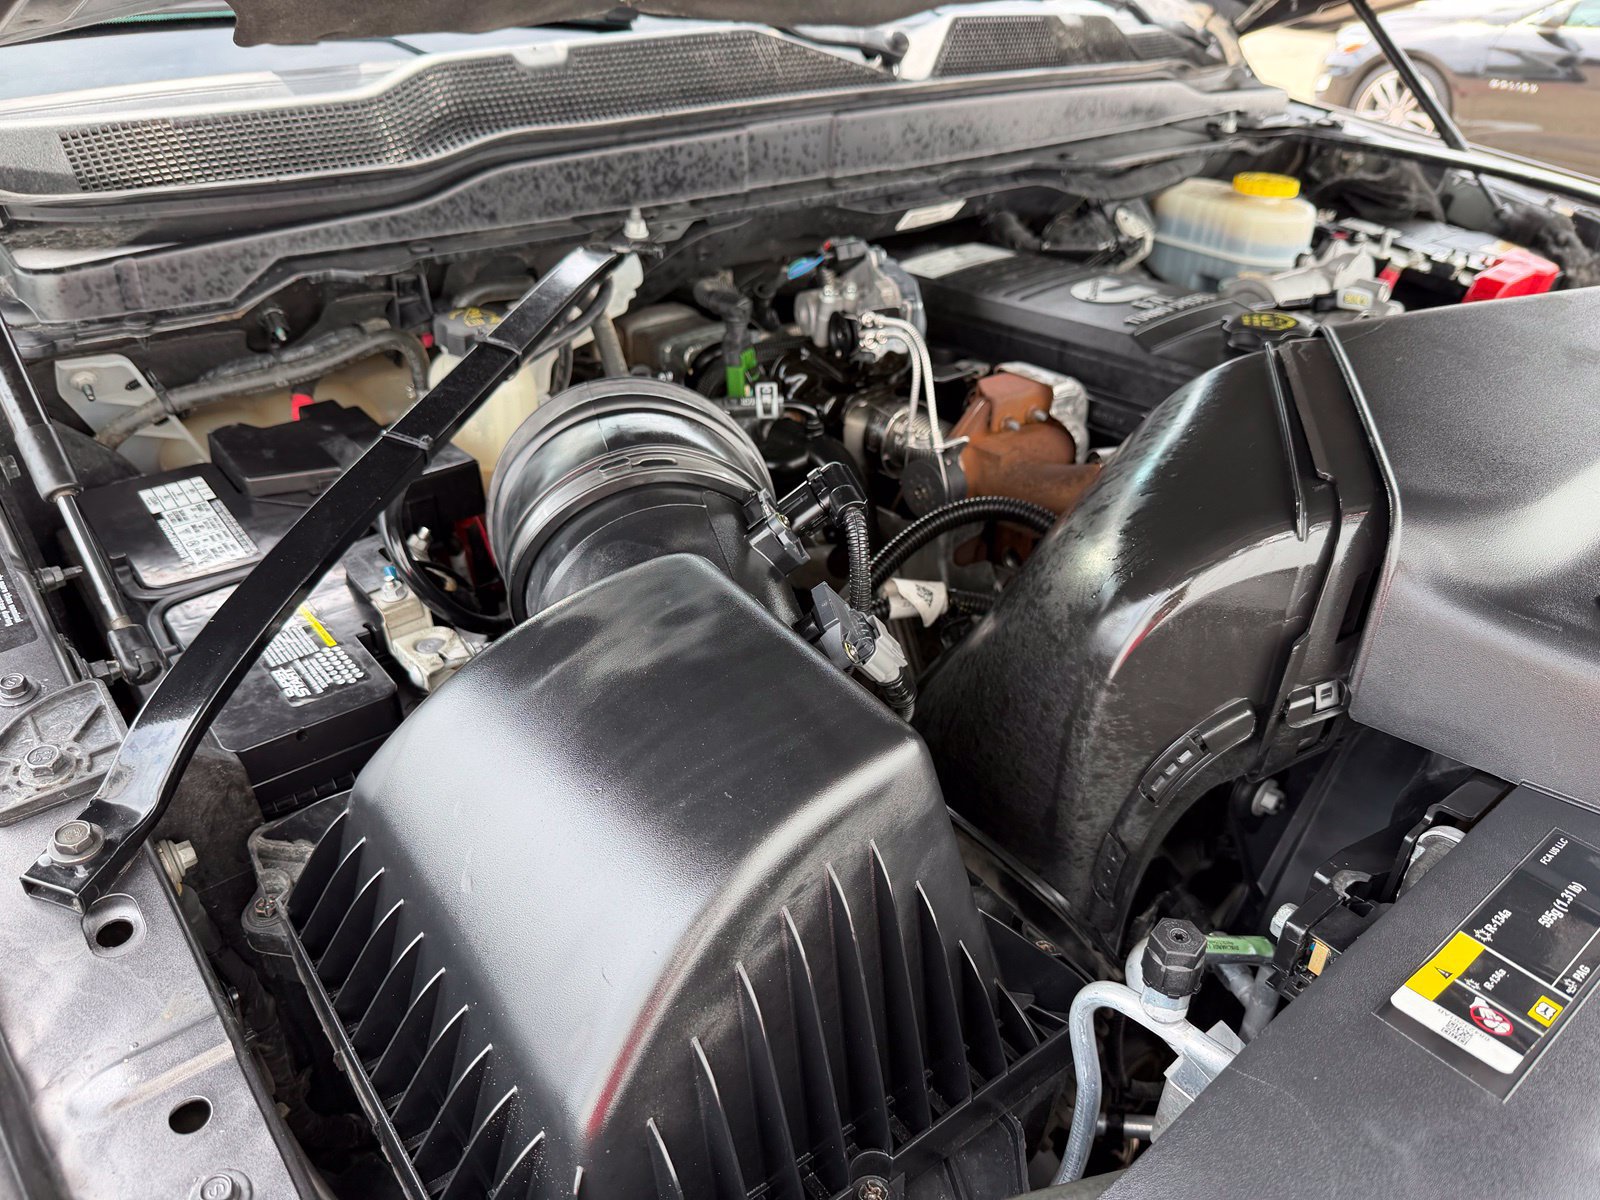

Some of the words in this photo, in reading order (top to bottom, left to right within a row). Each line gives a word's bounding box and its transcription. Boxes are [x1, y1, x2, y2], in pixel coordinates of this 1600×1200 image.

[270, 669, 296, 698] SUPER
[280, 665, 311, 698] START
[1540, 853, 1554, 866] FCA
[1550, 846, 1561, 856] US
[1556, 837, 1569, 849] LLC
[1538, 908, 1564, 928] 595g
[1553, 889, 1577, 912] (1.31
[1567, 881, 1587, 895] lb)
[1484, 908, 1512, 934] R-134a
[1483, 968, 1507, 991] R-134a
[1572, 964, 1591, 983] PAG
